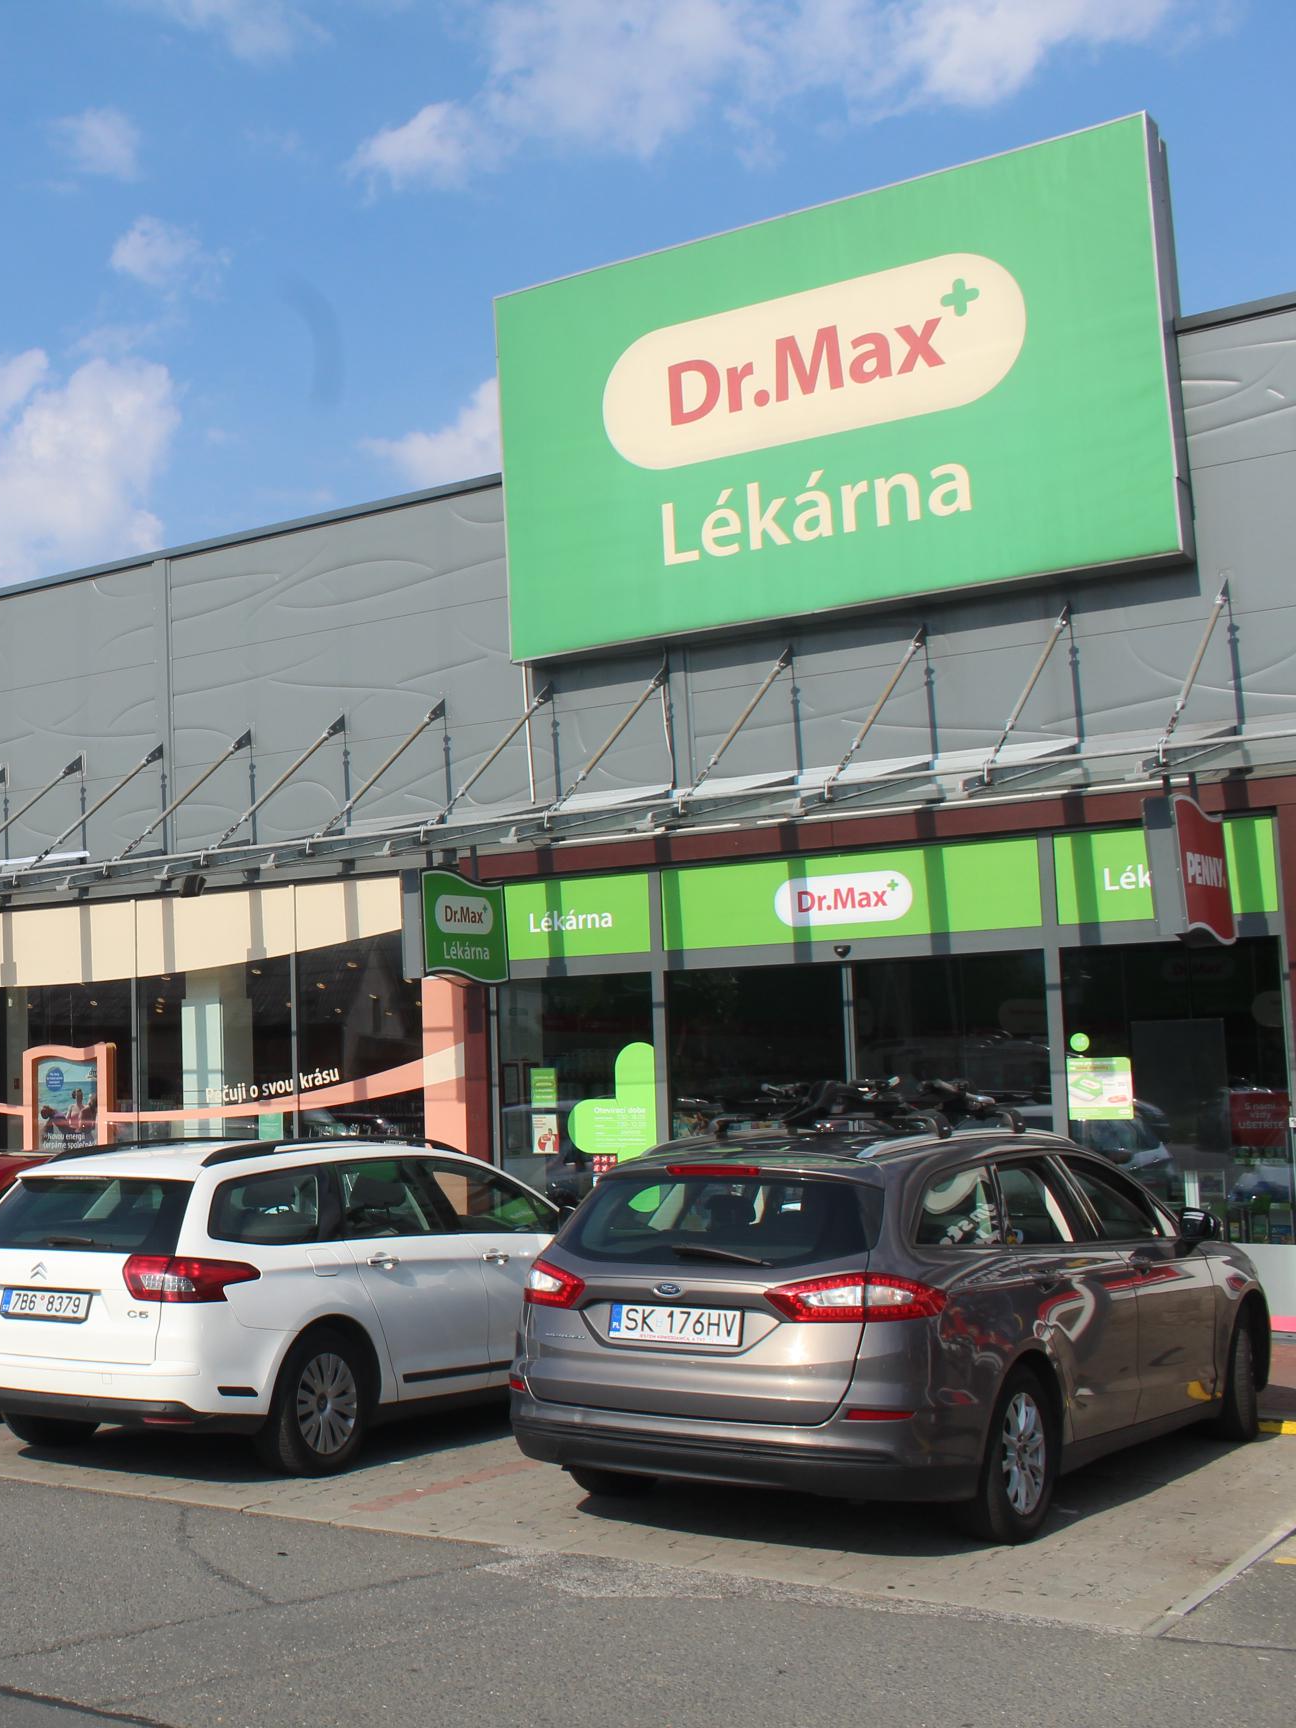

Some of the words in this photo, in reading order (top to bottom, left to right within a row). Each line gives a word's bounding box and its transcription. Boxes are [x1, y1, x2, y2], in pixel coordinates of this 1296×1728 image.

[661, 463, 973, 567] Lékárna
[797, 886, 888, 913] Dr.Max
[444, 905, 484, 924] Dr.Max
[528, 908, 613, 933] Lékárna
[443, 941, 490, 960] Lékárna
[205, 1082, 246, 1103] Pečuji
[249, 1085, 259, 1098] o
[262, 1078, 294, 1096] svou
[299, 1067, 340, 1089] krásu
[11, 1292, 36, 1312] 7B6
[45, 1294, 81, 1314] 8379
[127, 1310, 149, 1319] C5
[612, 1321, 621, 1329] PL
[624, 1307, 655, 1333] SK
[666, 1309, 737, 1338] 176HV
